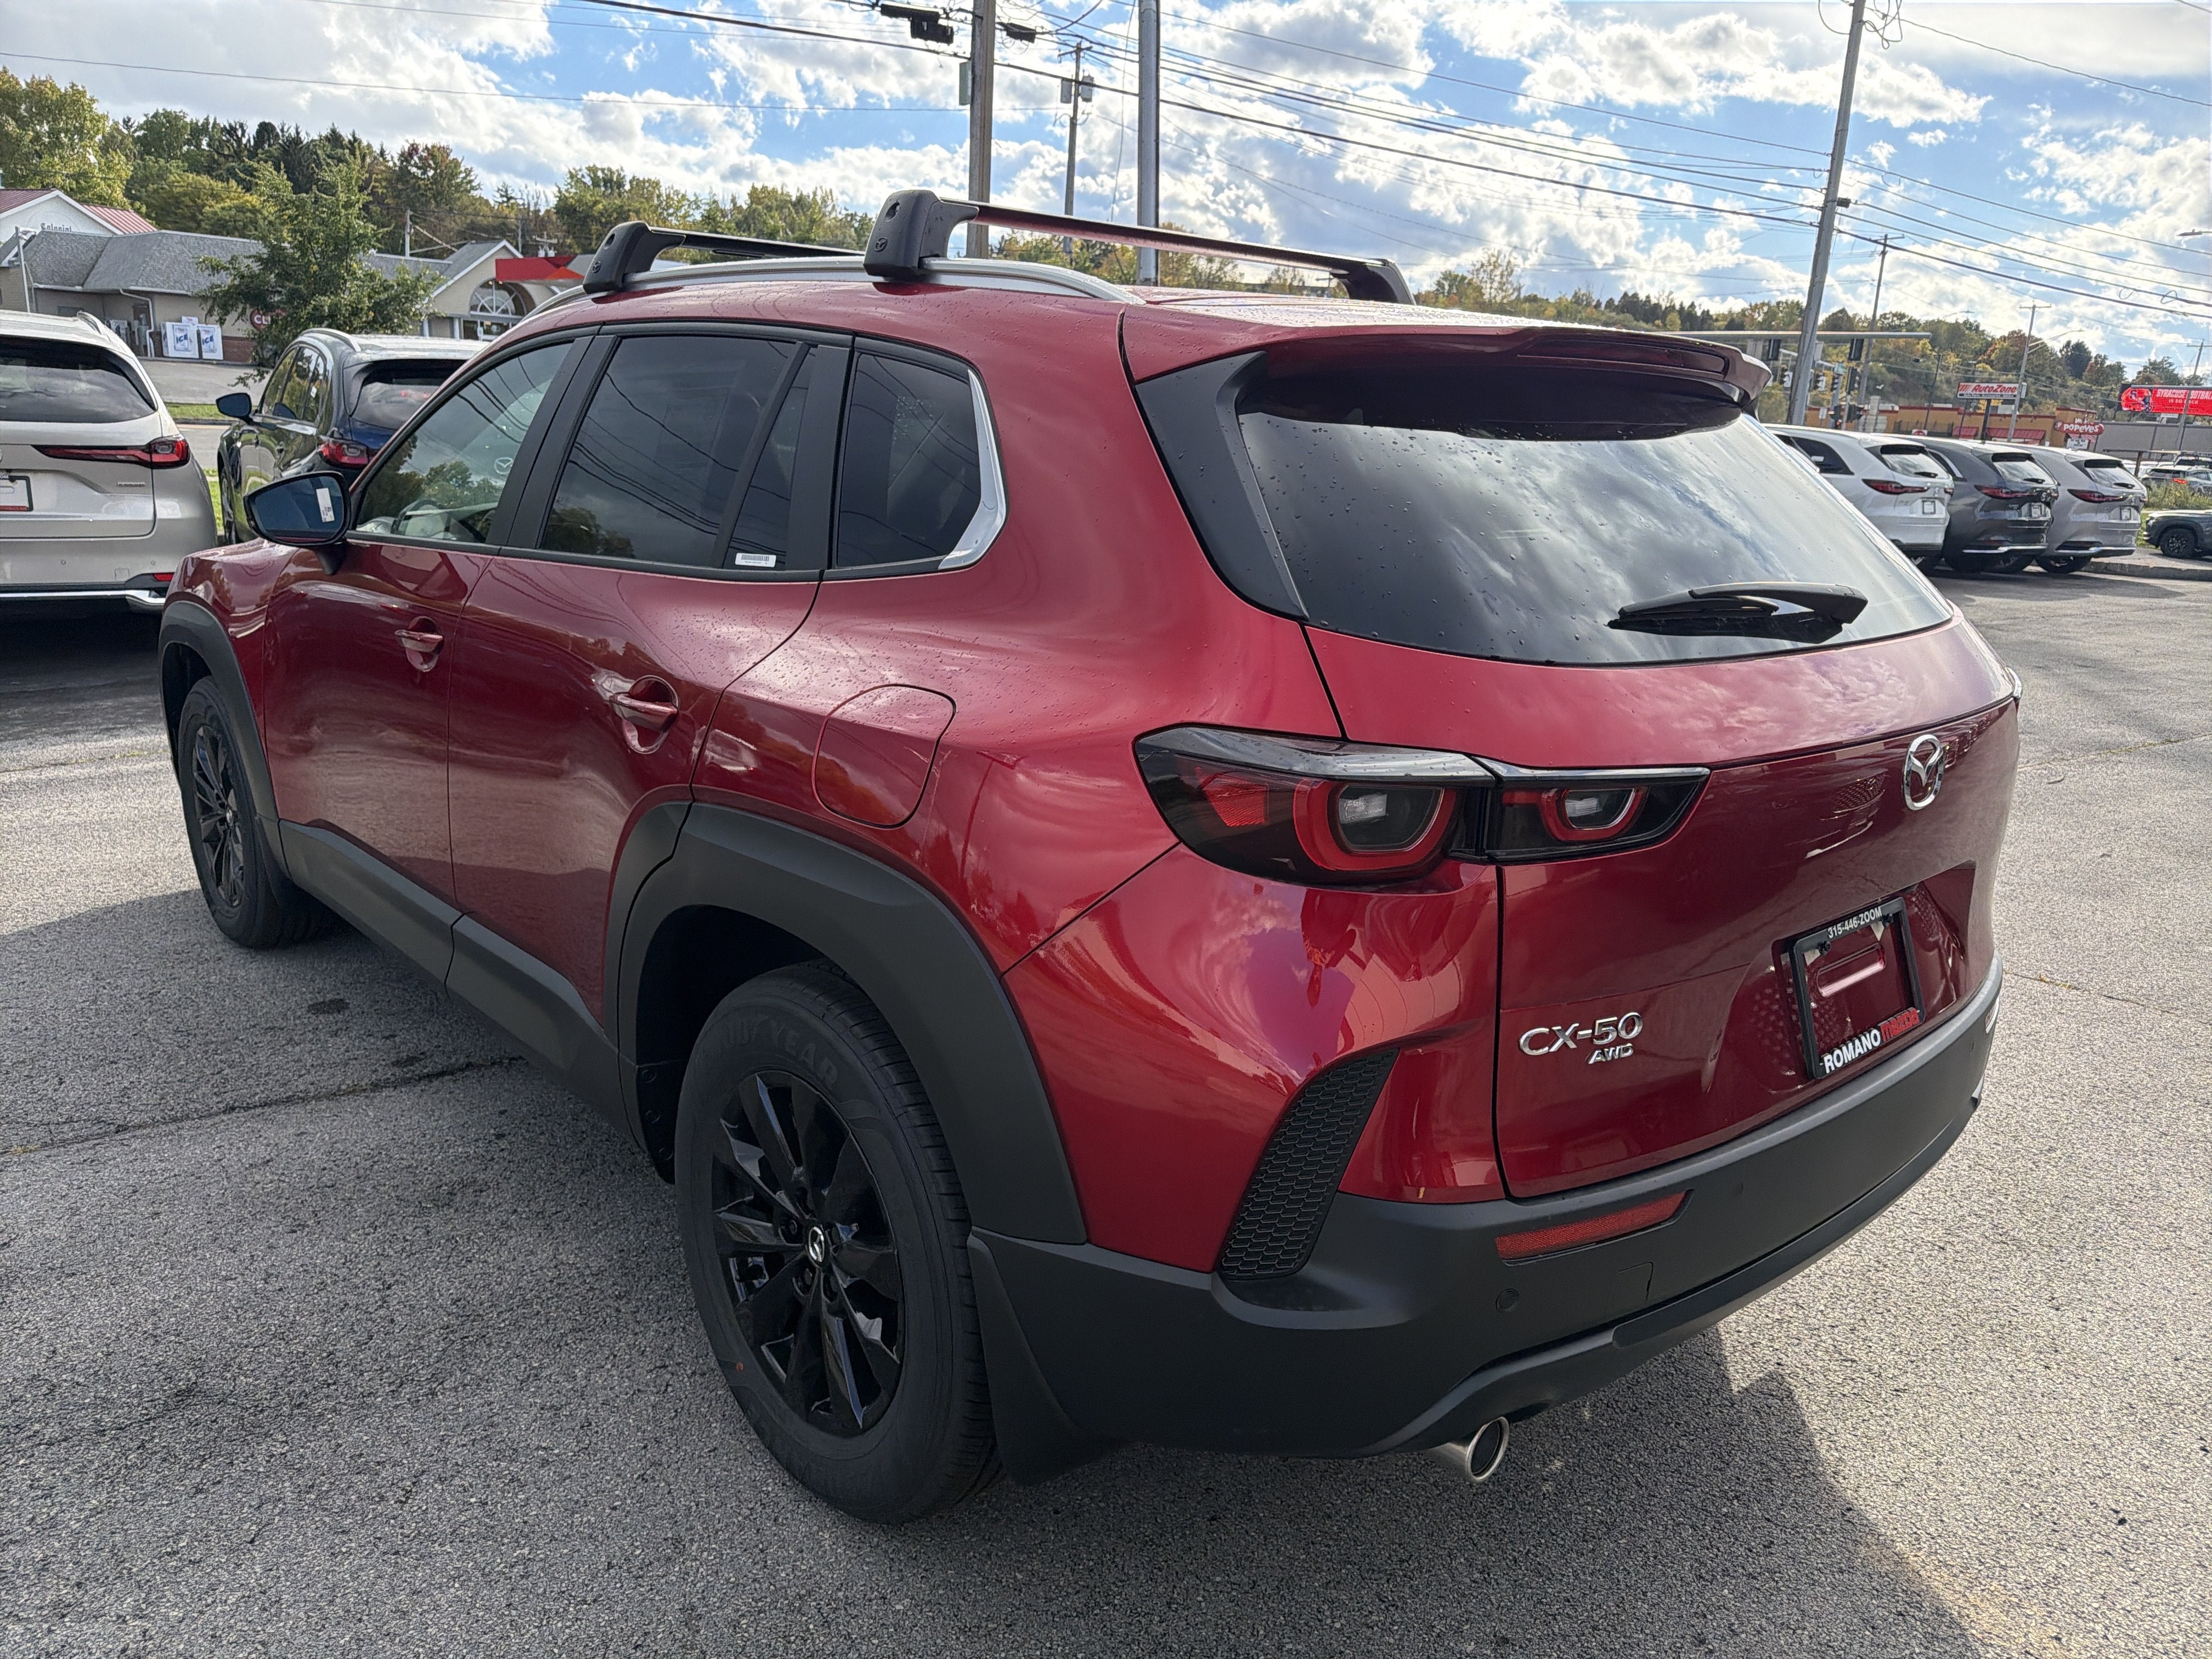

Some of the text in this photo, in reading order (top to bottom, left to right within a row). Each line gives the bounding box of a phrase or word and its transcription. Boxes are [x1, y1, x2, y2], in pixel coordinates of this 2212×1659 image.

[176, 334, 188, 344] ICE
[202, 335, 214, 346] ICE
[1971, 385, 2017, 393] AutoZone
[2156, 389, 2212, 399] SYRACUSE OOTBAL
[1827, 906, 1882, 939] 315-446-ZOOM
[1520, 1012, 1643, 1056] CX-50
[1588, 1043, 1634, 1064] AWD
[1824, 1029, 1881, 1074] ROMANO
